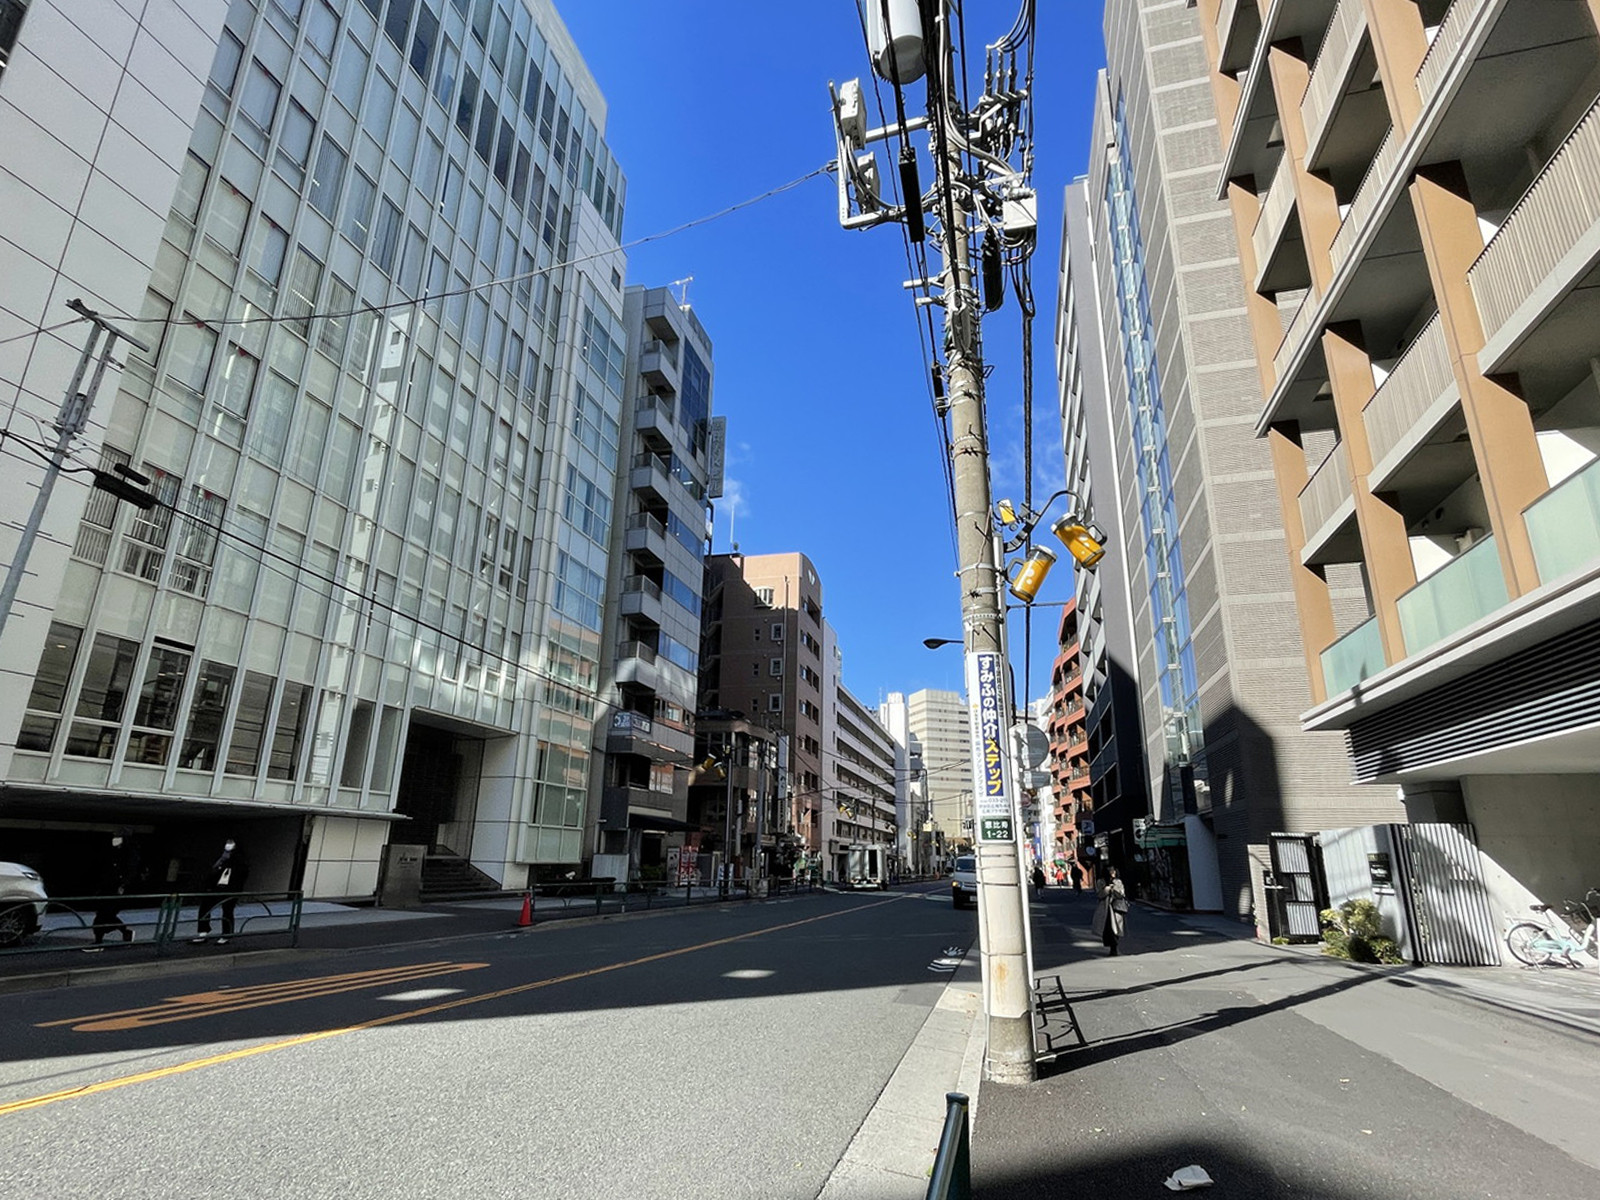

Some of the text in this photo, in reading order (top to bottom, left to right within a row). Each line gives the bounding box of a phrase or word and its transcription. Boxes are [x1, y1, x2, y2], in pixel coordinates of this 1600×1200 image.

[979, 655, 1002, 795] すみふの仲介ステップ
[984, 820, 1009, 829] 恵比寿
[986, 829, 1009, 839] 1-22
[33, 961, 491, 1032] 40
